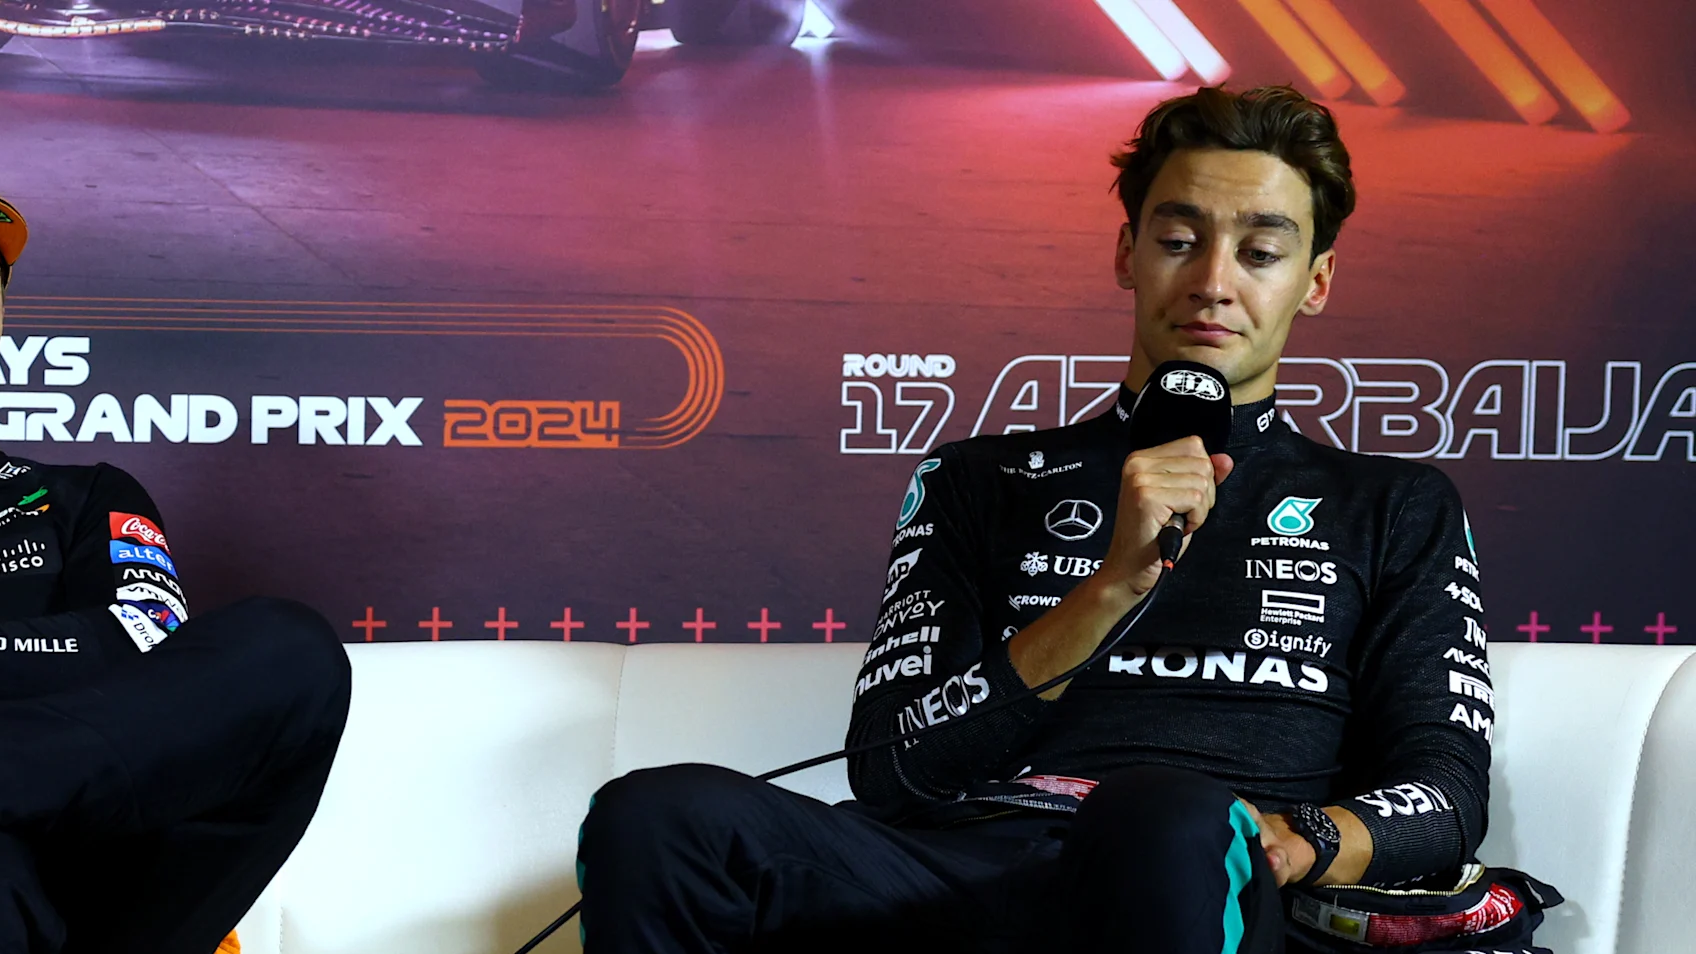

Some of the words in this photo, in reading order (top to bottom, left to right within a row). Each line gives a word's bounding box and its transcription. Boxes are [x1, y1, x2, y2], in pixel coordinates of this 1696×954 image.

[843, 354, 955, 378] ROUND
[252, 396, 423, 447] PRIX
[443, 399, 620, 447] 2024
[840, 381, 955, 454] 17
[1251, 536, 1330, 551] PETRONAS
[1245, 559, 1337, 584] INEOS
[1260, 615, 1302, 626] Enterprise
[1261, 608, 1294, 619] Hewlett
[1294, 610, 1324, 623] Packard
[14, 637, 79, 653] MILLE
[1108, 646, 1330, 693] RONAS
[897, 661, 990, 735] INEOS
